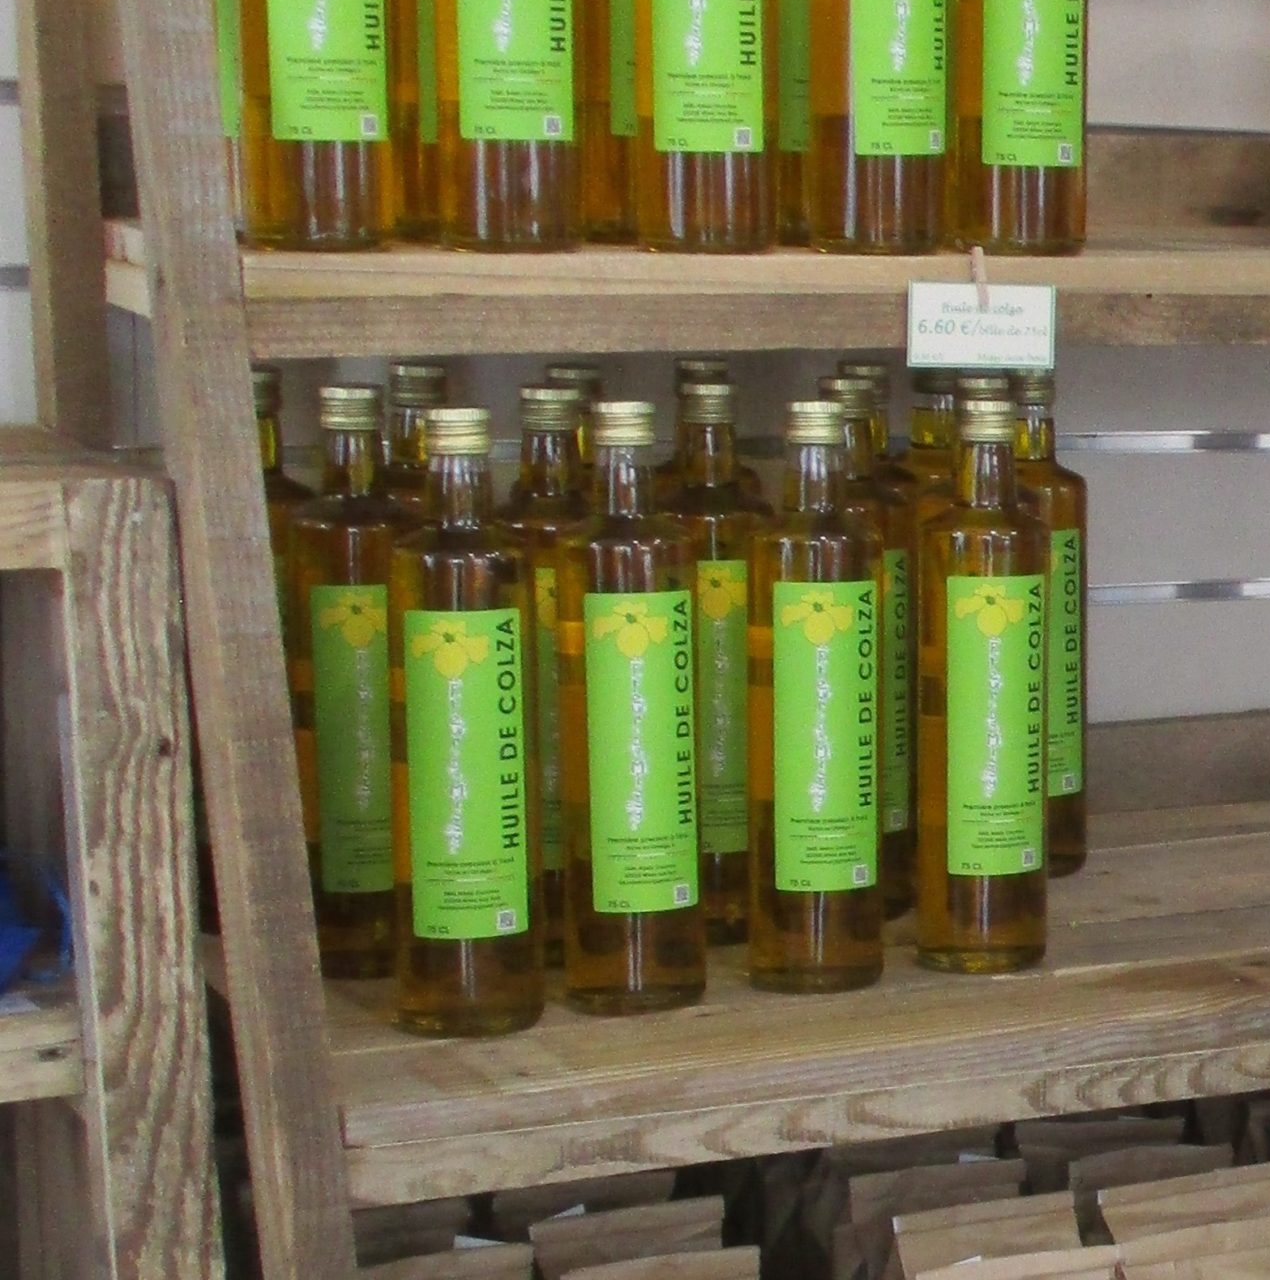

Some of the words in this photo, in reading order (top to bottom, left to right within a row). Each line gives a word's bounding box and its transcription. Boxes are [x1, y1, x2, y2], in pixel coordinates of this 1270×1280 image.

[1065, 12, 1080, 86] HUILE
[917, 319, 956, 335] 6.60
[894, 558, 906, 642] COLZA
[1063, 535, 1077, 615] COLZA
[673, 599, 690, 694] COLZA
[858, 589, 873, 681] COLZA
[1027, 583, 1041, 670] COLZA
[1064, 624, 1078, 653] DE
[495, 617, 517, 715] COLZA
[894, 649, 906, 680] DE
[1027, 680, 1041, 713] DE
[1065, 663, 1079, 724] HUILE
[675, 705, 691, 739] DE
[858, 691, 873, 724] DE
[895, 689, 906, 758] HUILE
[499, 727, 518, 761] DE
[858, 734, 873, 807] HUILE
[1027, 723, 1041, 793] HUILE
[500, 772, 520, 849] HUILE
[676, 749, 692, 825] HUILE
